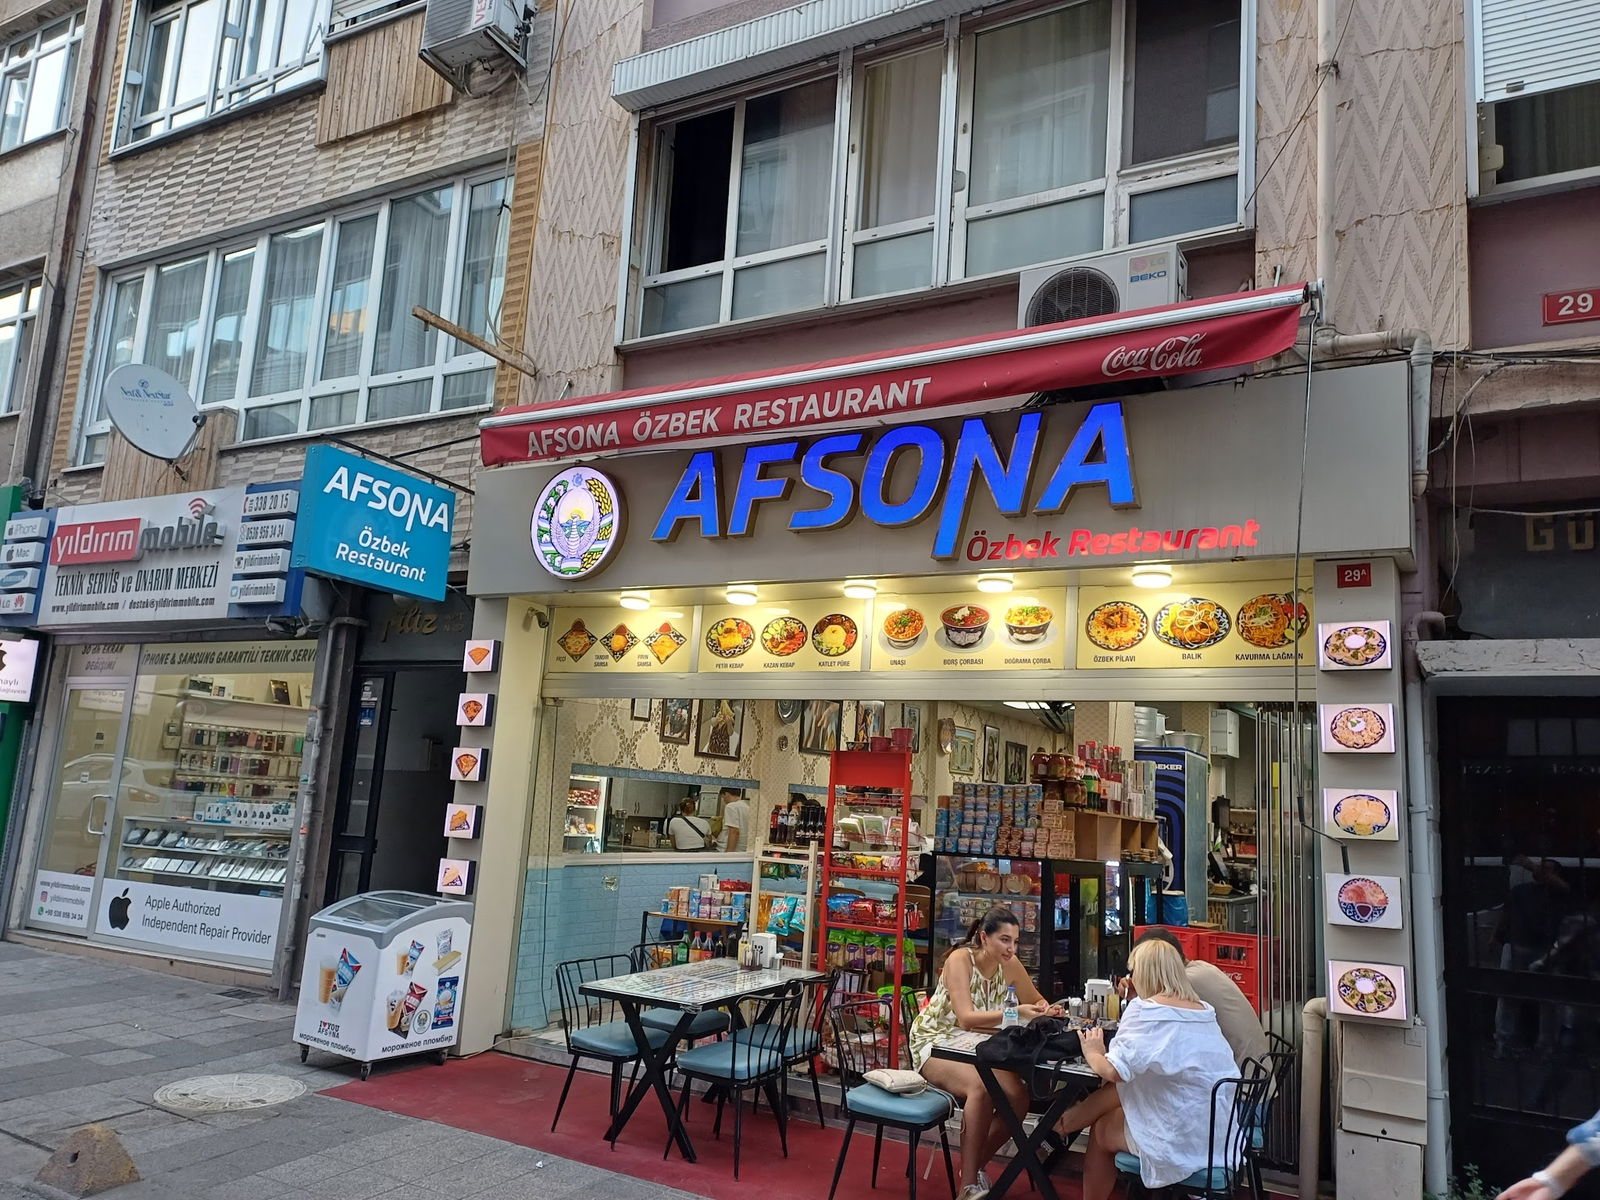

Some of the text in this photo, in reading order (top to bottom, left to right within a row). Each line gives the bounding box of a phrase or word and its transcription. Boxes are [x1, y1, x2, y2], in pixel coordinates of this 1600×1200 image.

[1130, 270, 1167, 283] BEKO
[1558, 293, 1593, 316] 29
[1101, 332, 1208, 377] Coca-Cola
[526, 377, 932, 457] AFSONA ÖZBEK RESTAURANT
[650, 401, 1138, 560] AFSONA
[254, 496, 268, 512] 338
[268, 494, 279, 510] 20
[280, 493, 289, 509] 15
[323, 466, 449, 533] AFSONA
[14, 524, 37, 534] iPhone
[55, 514, 221, 562] yıldırım mobile
[966, 518, 1261, 562] Özbek Restaurant
[16, 548, 30, 558] Mac
[358, 525, 411, 560] Özbek
[336, 543, 427, 583] Restaurant
[54, 561, 220, 597] TEKNİK SERVİS ve ONARIM MERKEZİ
[177, 652, 214, 665] SAMSUNG
[216, 646, 260, 664] GARANTİLİ
[260, 645, 291, 663] TEKNİK
[959, 658, 984, 666] ÇORBASI
[1033, 657, 1051, 665] ÇORBA
[1093, 653, 1136, 663] ÖZBEK PİLAVI
[1235, 652, 1304, 661] KAVURMA LAĞMN
[144, 895, 221, 917] Apple Authorized
[141, 914, 272, 946] Independent Repair Provider
[327, 1022, 340, 1032] YOU
[299, 1032, 357, 1055] мороженое пломбир
[381, 1034, 453, 1054] мороженое пломбир
